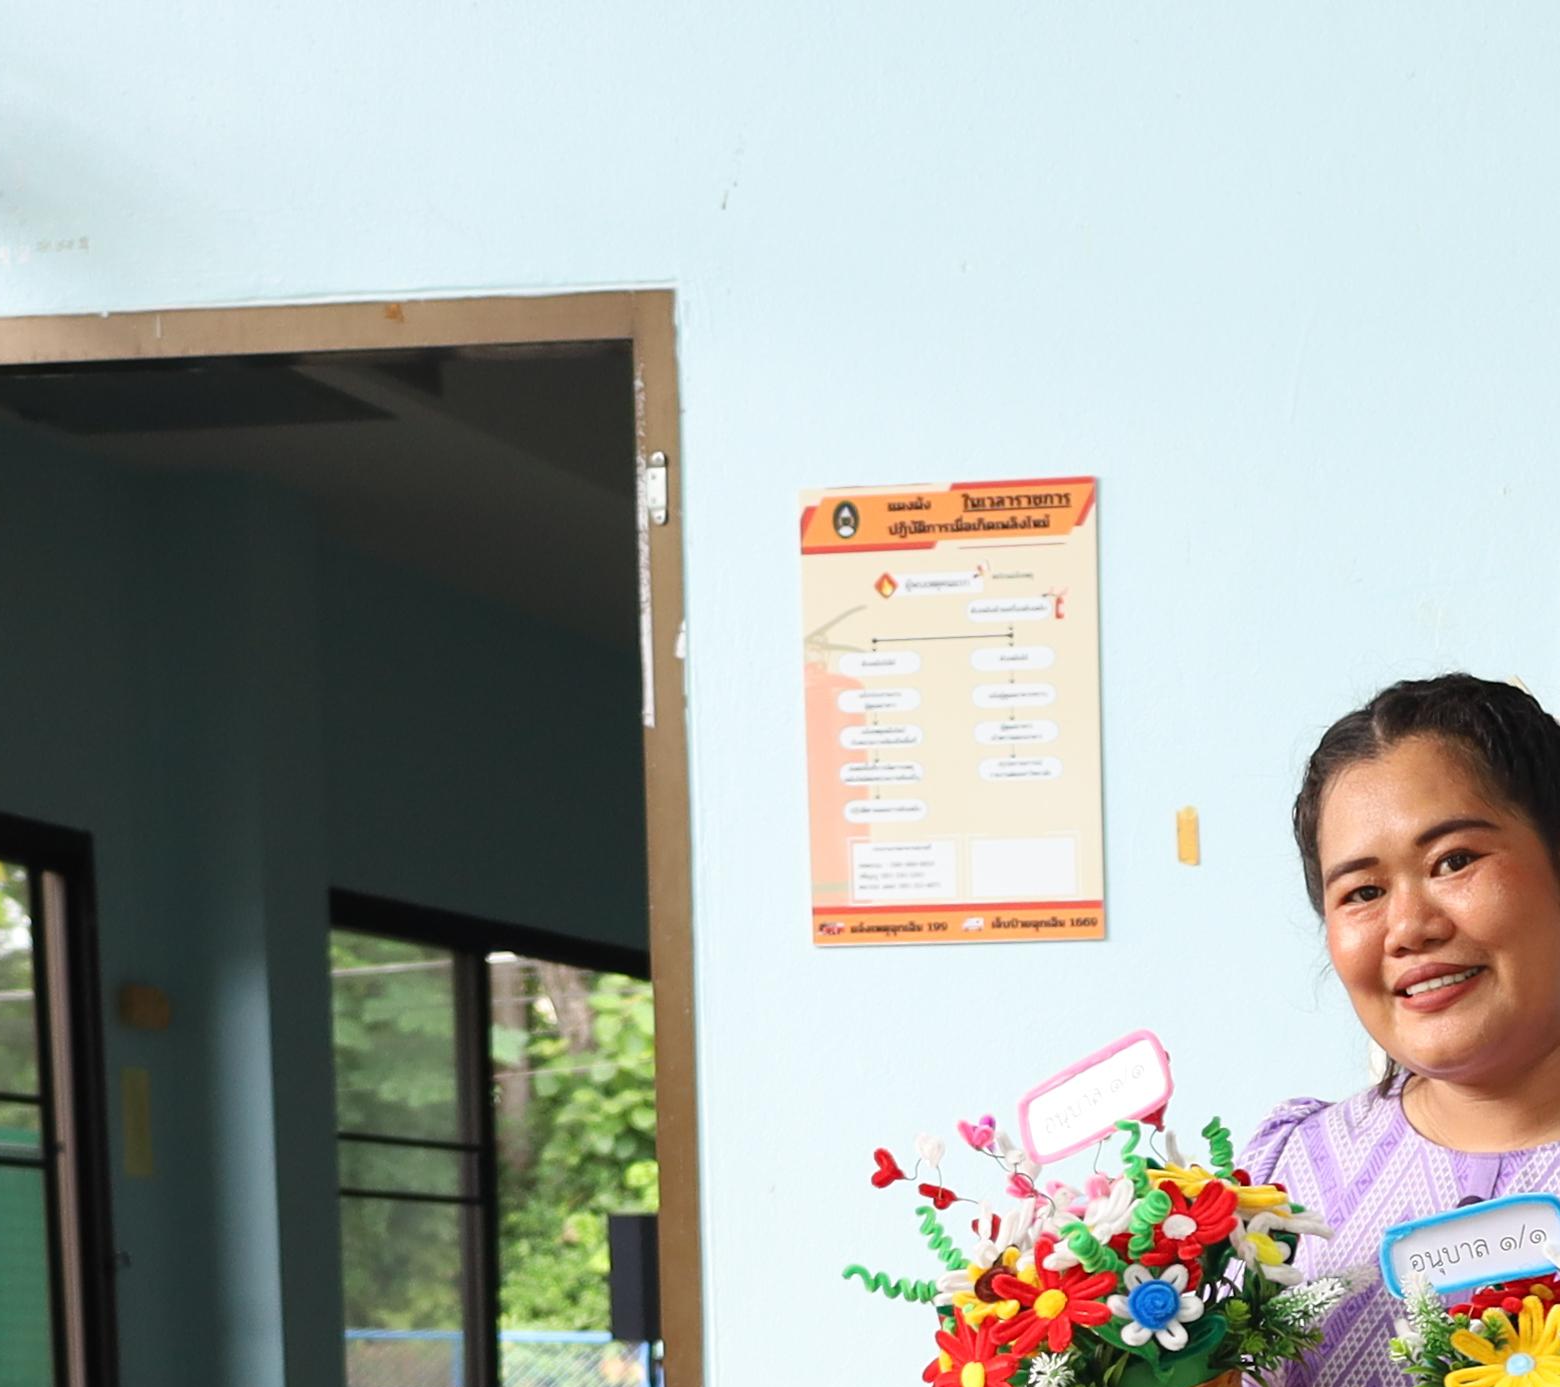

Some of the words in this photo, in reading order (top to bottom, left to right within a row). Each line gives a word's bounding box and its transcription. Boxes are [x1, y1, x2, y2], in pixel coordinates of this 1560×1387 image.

[927, 921, 948, 933] 199
[1069, 916, 1098, 928] 1669
[1408, 1237, 1490, 1276] อนุบาล
[1499, 1223, 1548, 1252] ๑/๑
